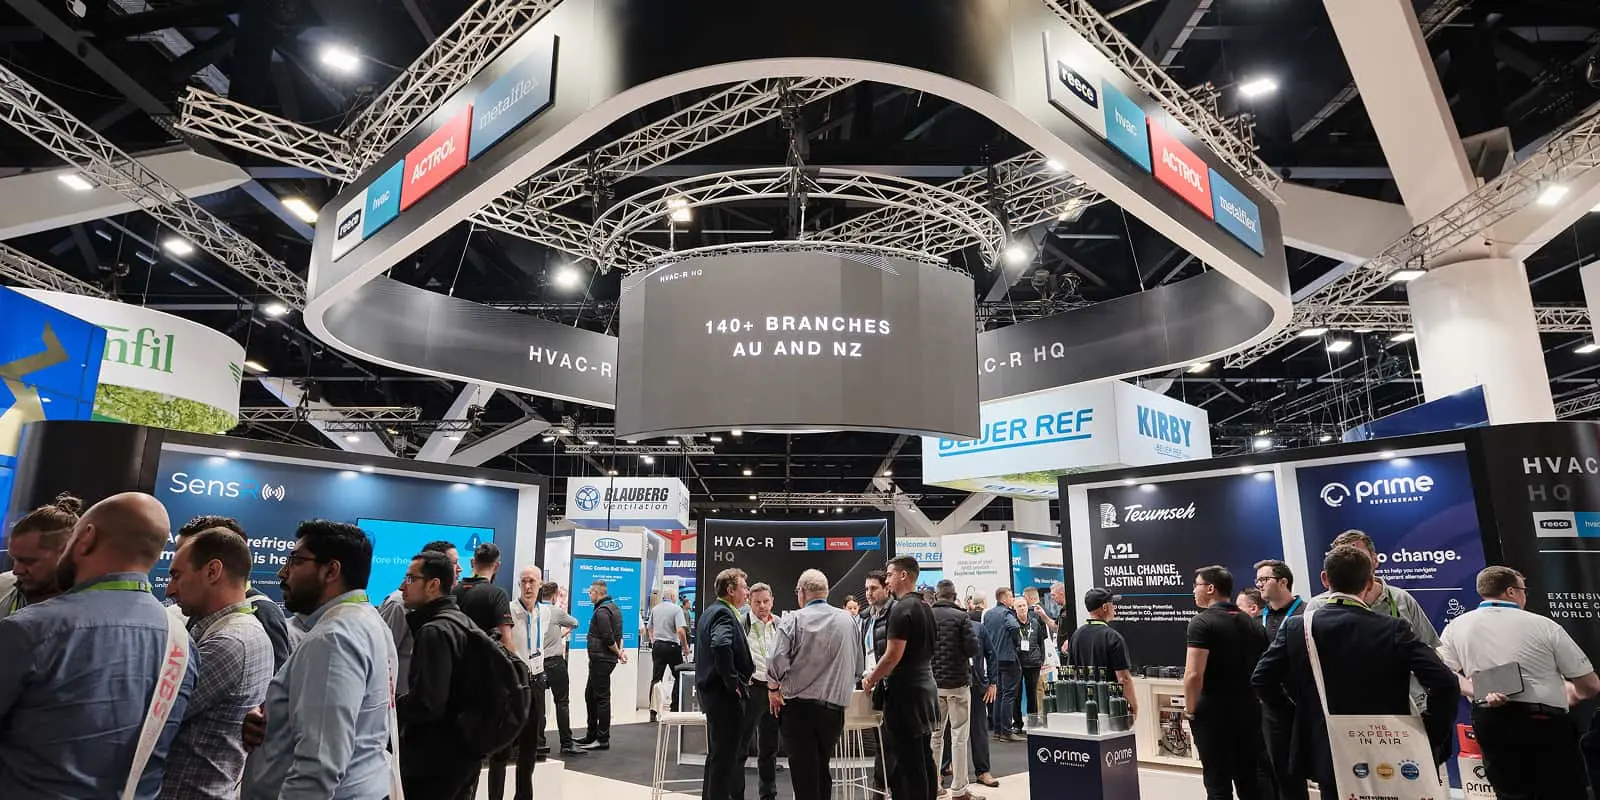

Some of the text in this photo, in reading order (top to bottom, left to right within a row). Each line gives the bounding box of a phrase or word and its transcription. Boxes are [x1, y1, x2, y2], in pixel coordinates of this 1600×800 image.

[1061, 67, 1095, 102] reece
[478, 76, 540, 130] metalflex
[1114, 107, 1138, 137] hvac
[411, 136, 456, 184] ACTROL
[1161, 147, 1204, 192] ACTROL
[372, 189, 391, 212] hvac
[1219, 196, 1257, 233] metalflex
[339, 212, 360, 237] reece
[659, 269, 703, 283] HVAC-R HQ
[705, 316, 891, 335] 140+ BRANCHES
[733, 341, 862, 358] AU AND NZ
[1033, 342, 1066, 364] HQ
[529, 345, 612, 378] HVAC-R
[938, 408, 1095, 451] BJER REF
[1136, 404, 1192, 447] KIRBY
[169, 472, 261, 500] SensR
[604, 487, 669, 502] BLAUBERG
[1355, 474, 1434, 504] prime
[1527, 484, 1572, 502] HQ
[1369, 495, 1424, 505] REFRIGERANT
[1124, 502, 1196, 523] Tecumseh
[1543, 520, 1569, 528] reece
[598, 538, 621, 549] DURA
[713, 535, 774, 549] HVAC-R
[254, 552, 266, 564] is
[713, 551, 735, 562] HQ
[1103, 543, 1139, 560] A2L
[1391, 548, 1462, 564] change.
[1103, 564, 1179, 577] SMALL CHANGE,
[1104, 575, 1184, 587] LASTING IMPACT.
[1549, 601, 1590, 609] RANGE
[1348, 730, 1410, 738] EXPERTS
[1053, 749, 1091, 763] prime
[1114, 748, 1133, 765] prime
